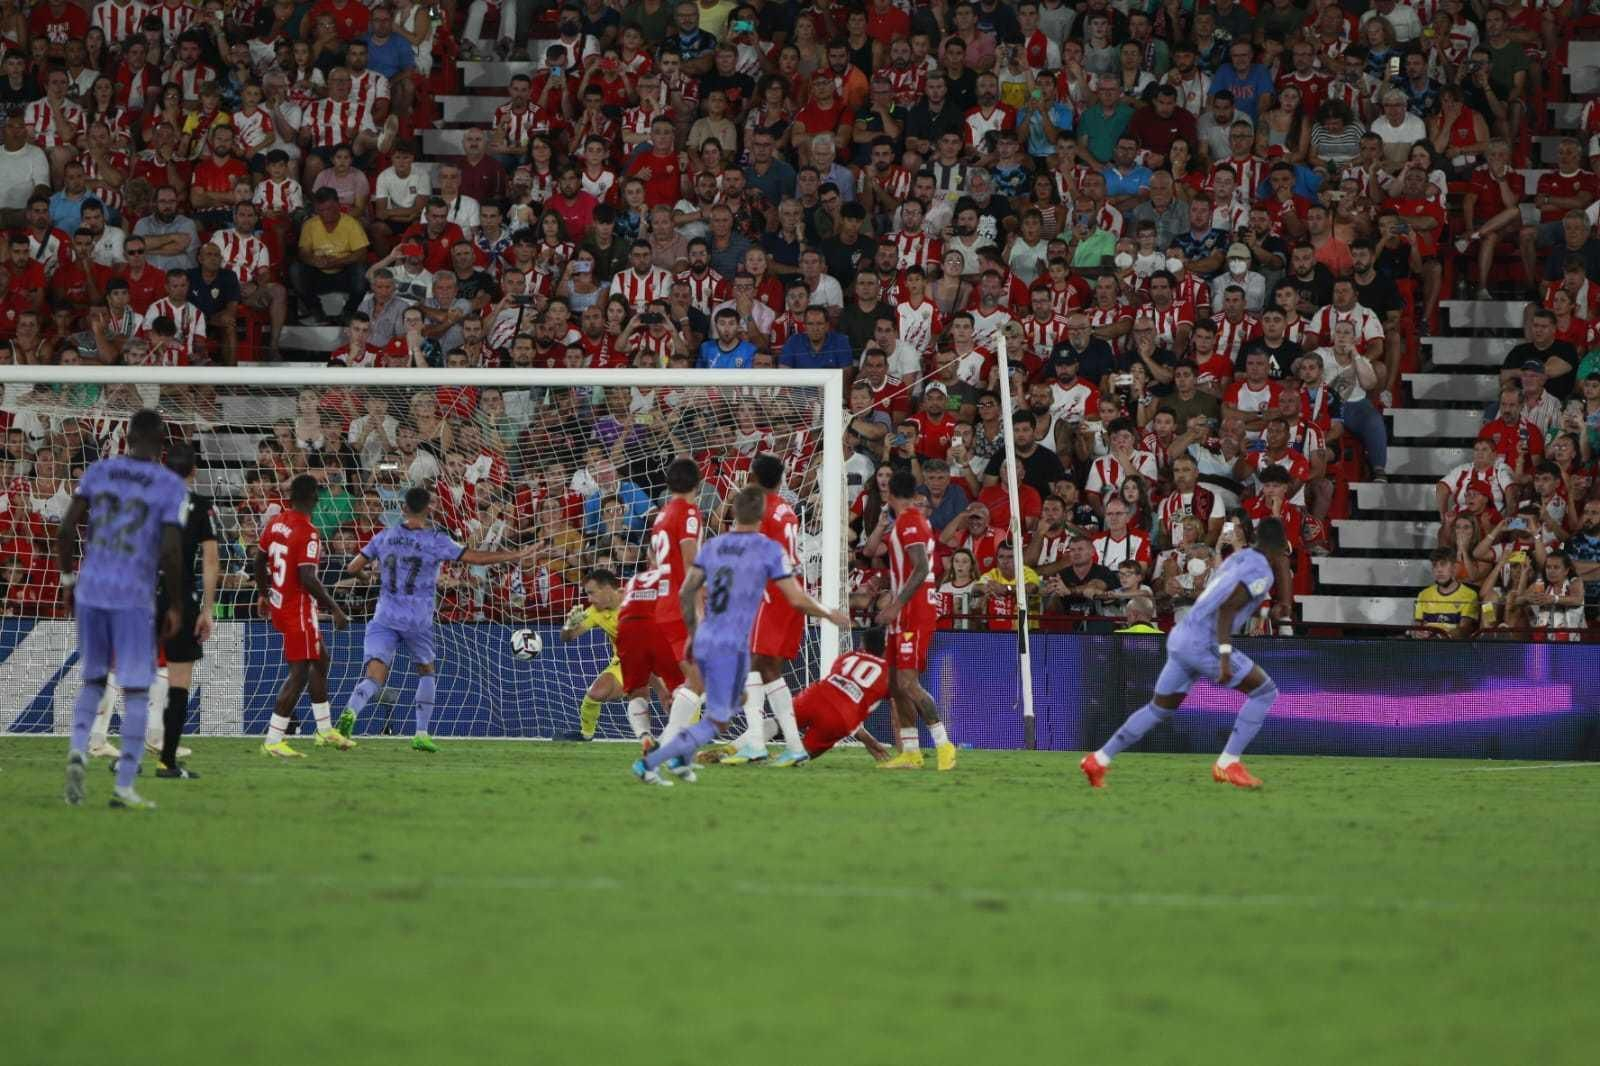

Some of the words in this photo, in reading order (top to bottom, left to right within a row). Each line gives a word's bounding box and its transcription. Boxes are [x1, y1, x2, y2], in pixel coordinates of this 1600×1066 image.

[91, 491, 149, 555] 22
[384, 553, 422, 595] 17
[711, 565, 734, 615] 8
[841, 655, 882, 688] 10
